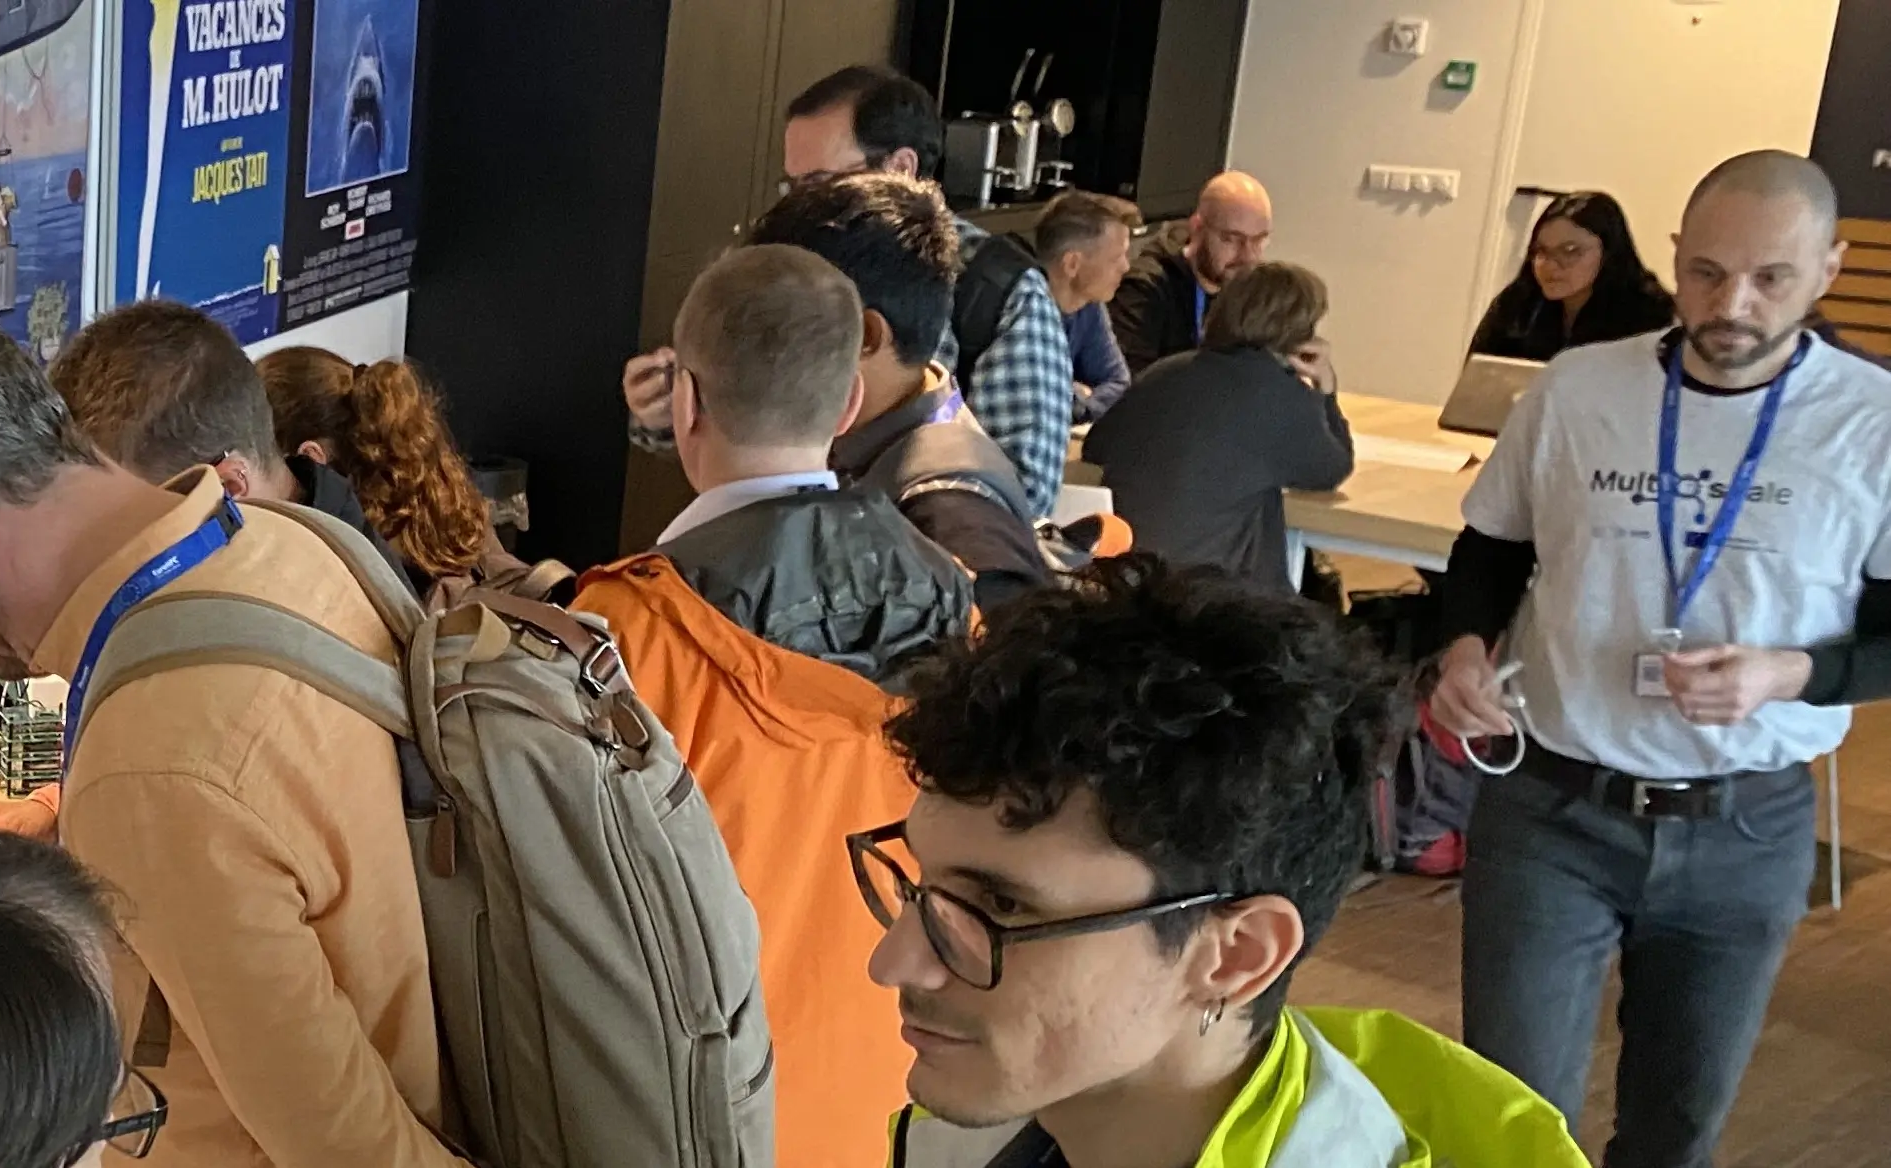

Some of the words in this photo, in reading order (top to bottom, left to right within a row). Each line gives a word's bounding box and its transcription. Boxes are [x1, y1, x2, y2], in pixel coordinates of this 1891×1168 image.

[185, 0, 286, 53] VACANCES
[192, 157, 245, 205] JACQUES
[245, 152, 268, 189] TATI
